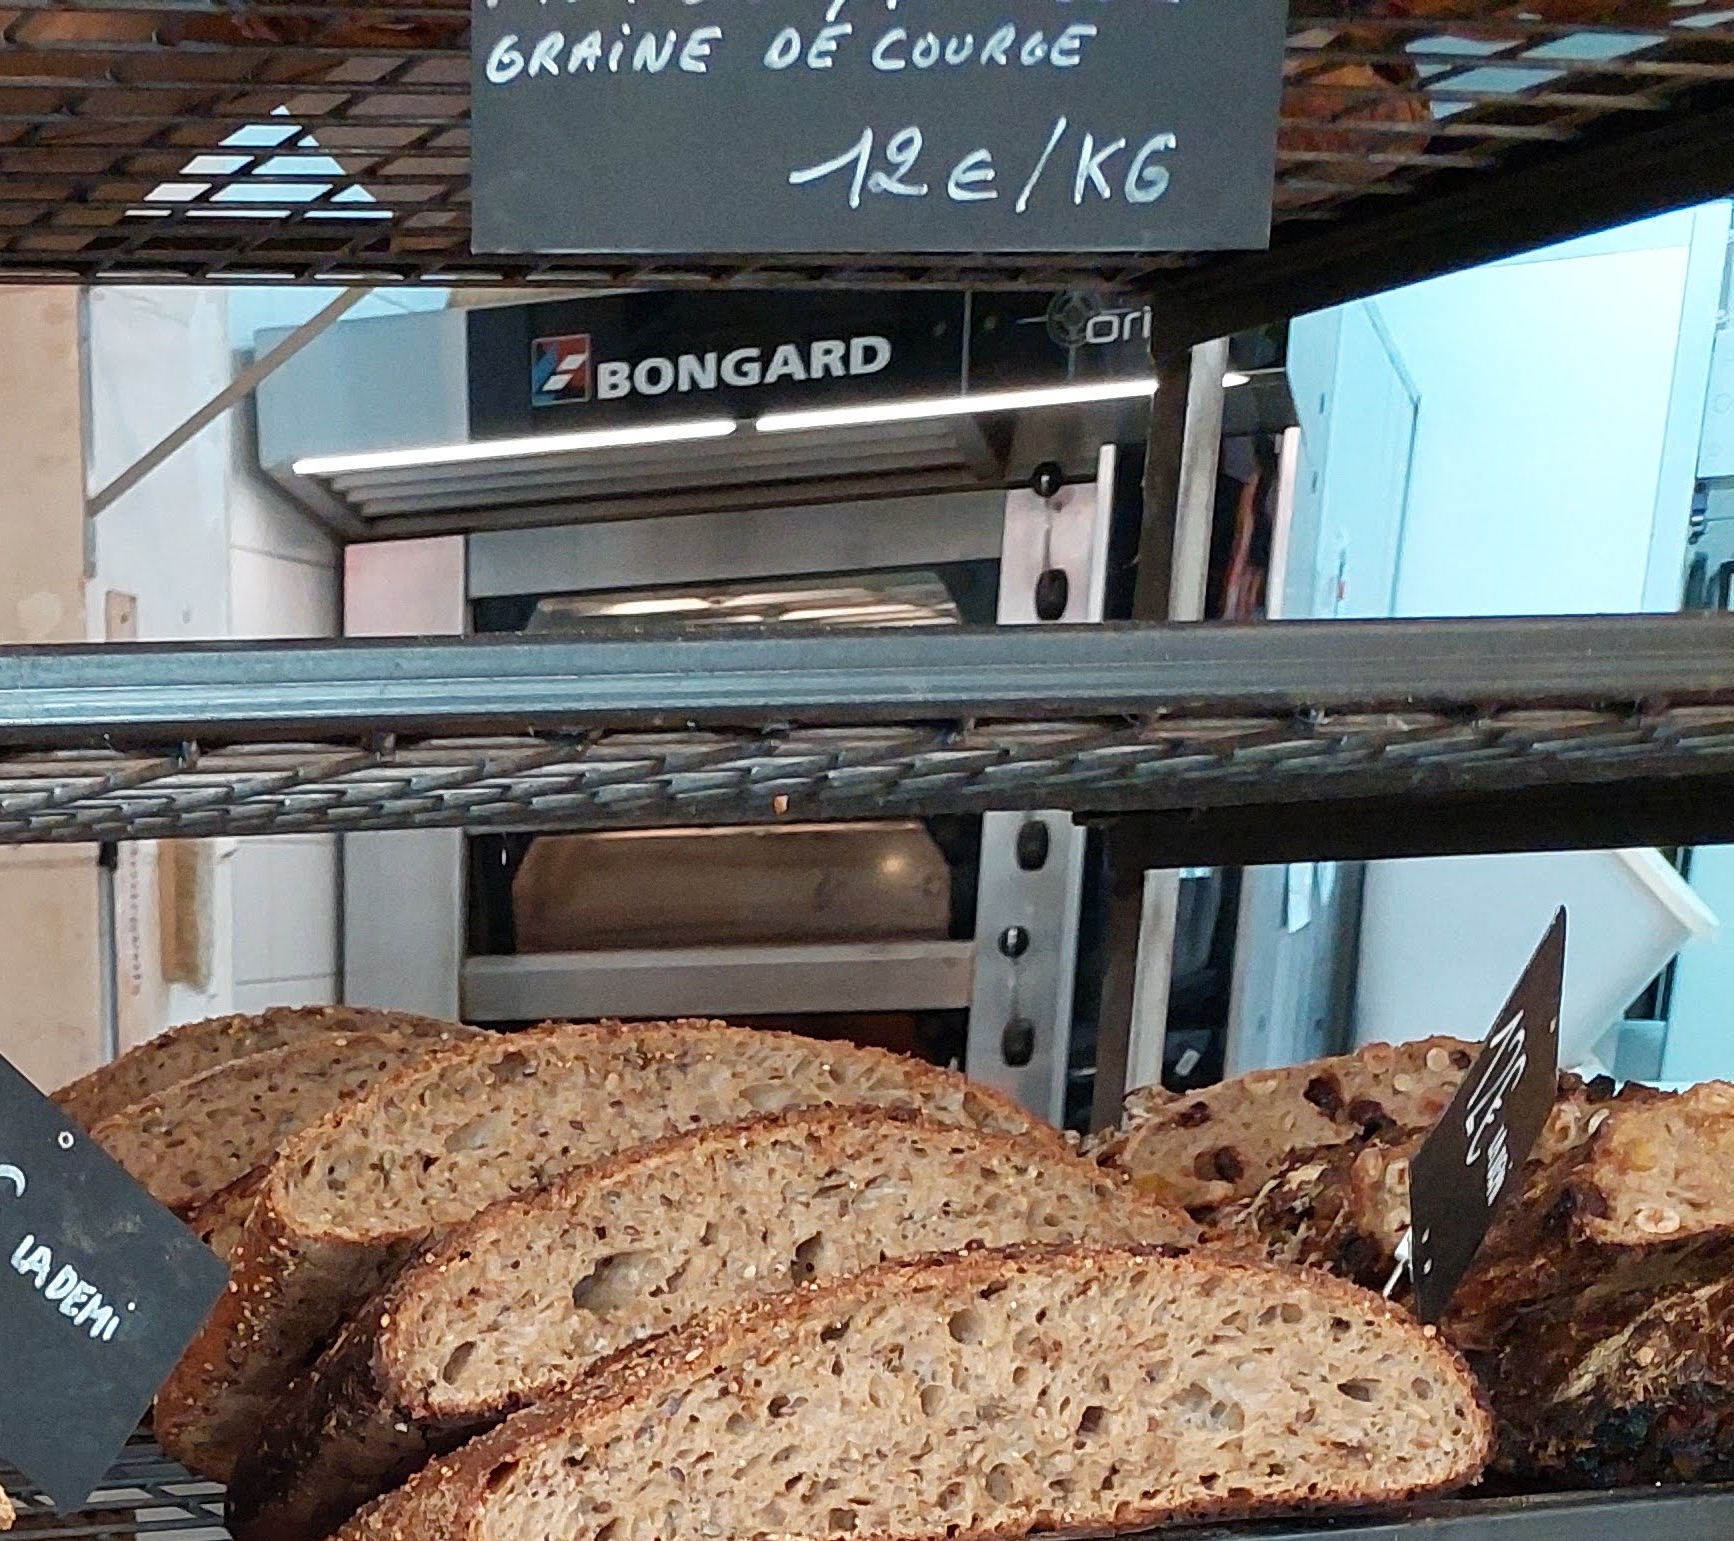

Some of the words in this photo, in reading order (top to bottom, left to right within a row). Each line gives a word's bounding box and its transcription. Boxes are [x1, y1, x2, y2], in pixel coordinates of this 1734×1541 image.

[871, 23, 1098, 70] COURGE
[596, 335, 893, 399] BONGARD
[10, 1233, 51, 1290] LA
